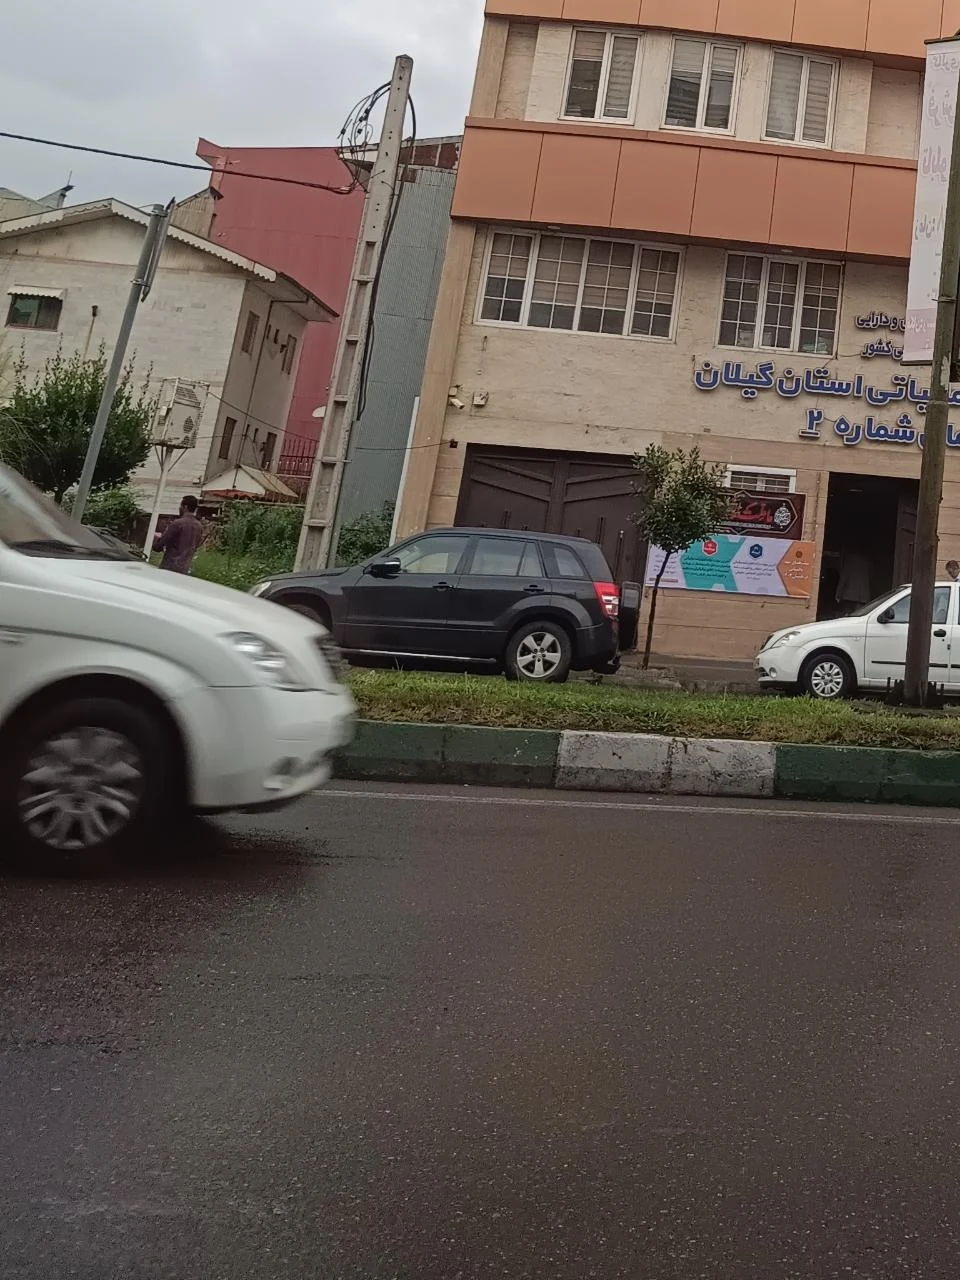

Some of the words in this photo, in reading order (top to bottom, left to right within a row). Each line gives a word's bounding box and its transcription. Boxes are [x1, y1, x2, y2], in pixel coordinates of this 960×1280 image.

[856, 311, 890, 328] دارایی
[862, 337, 893, 357] کشور
[694, 361, 775, 399] گیلان
[776, 367, 863, 397] استان
[834, 413, 917, 446] شماره
